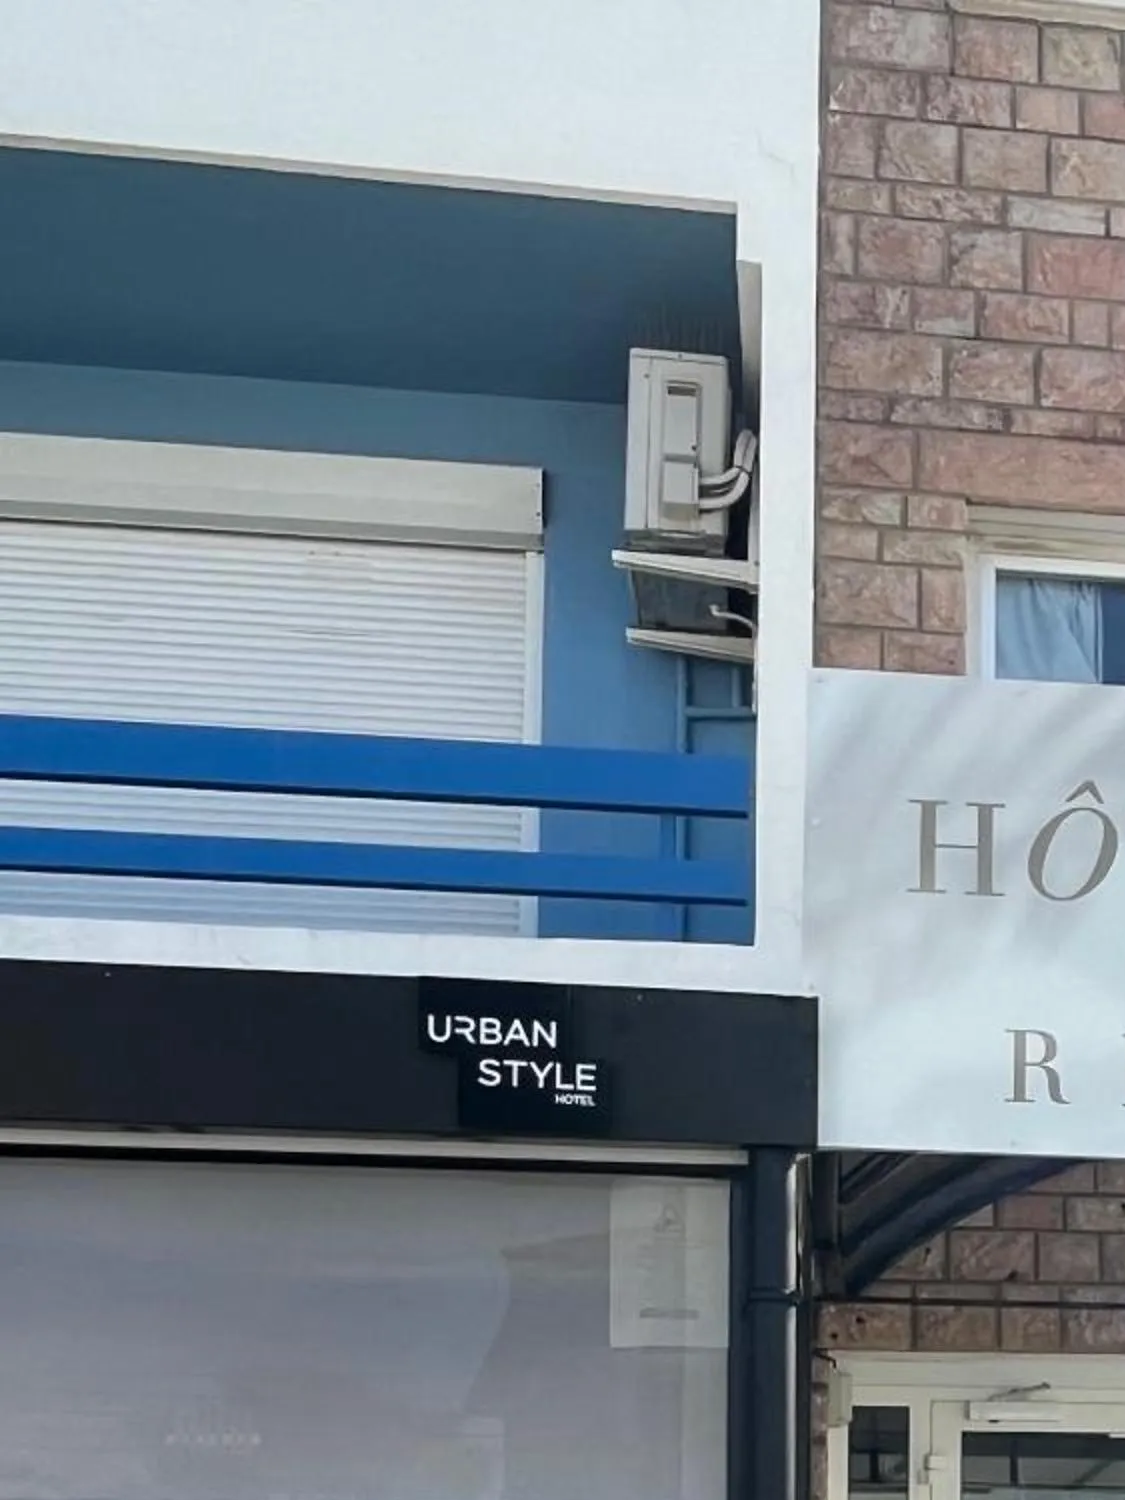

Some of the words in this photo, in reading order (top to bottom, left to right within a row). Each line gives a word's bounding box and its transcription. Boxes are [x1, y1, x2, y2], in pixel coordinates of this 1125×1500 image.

[427, 1013, 557, 1048] URBAN
[477, 1058, 597, 1091] STYLE
[554, 1093, 596, 1106] HOTEL
